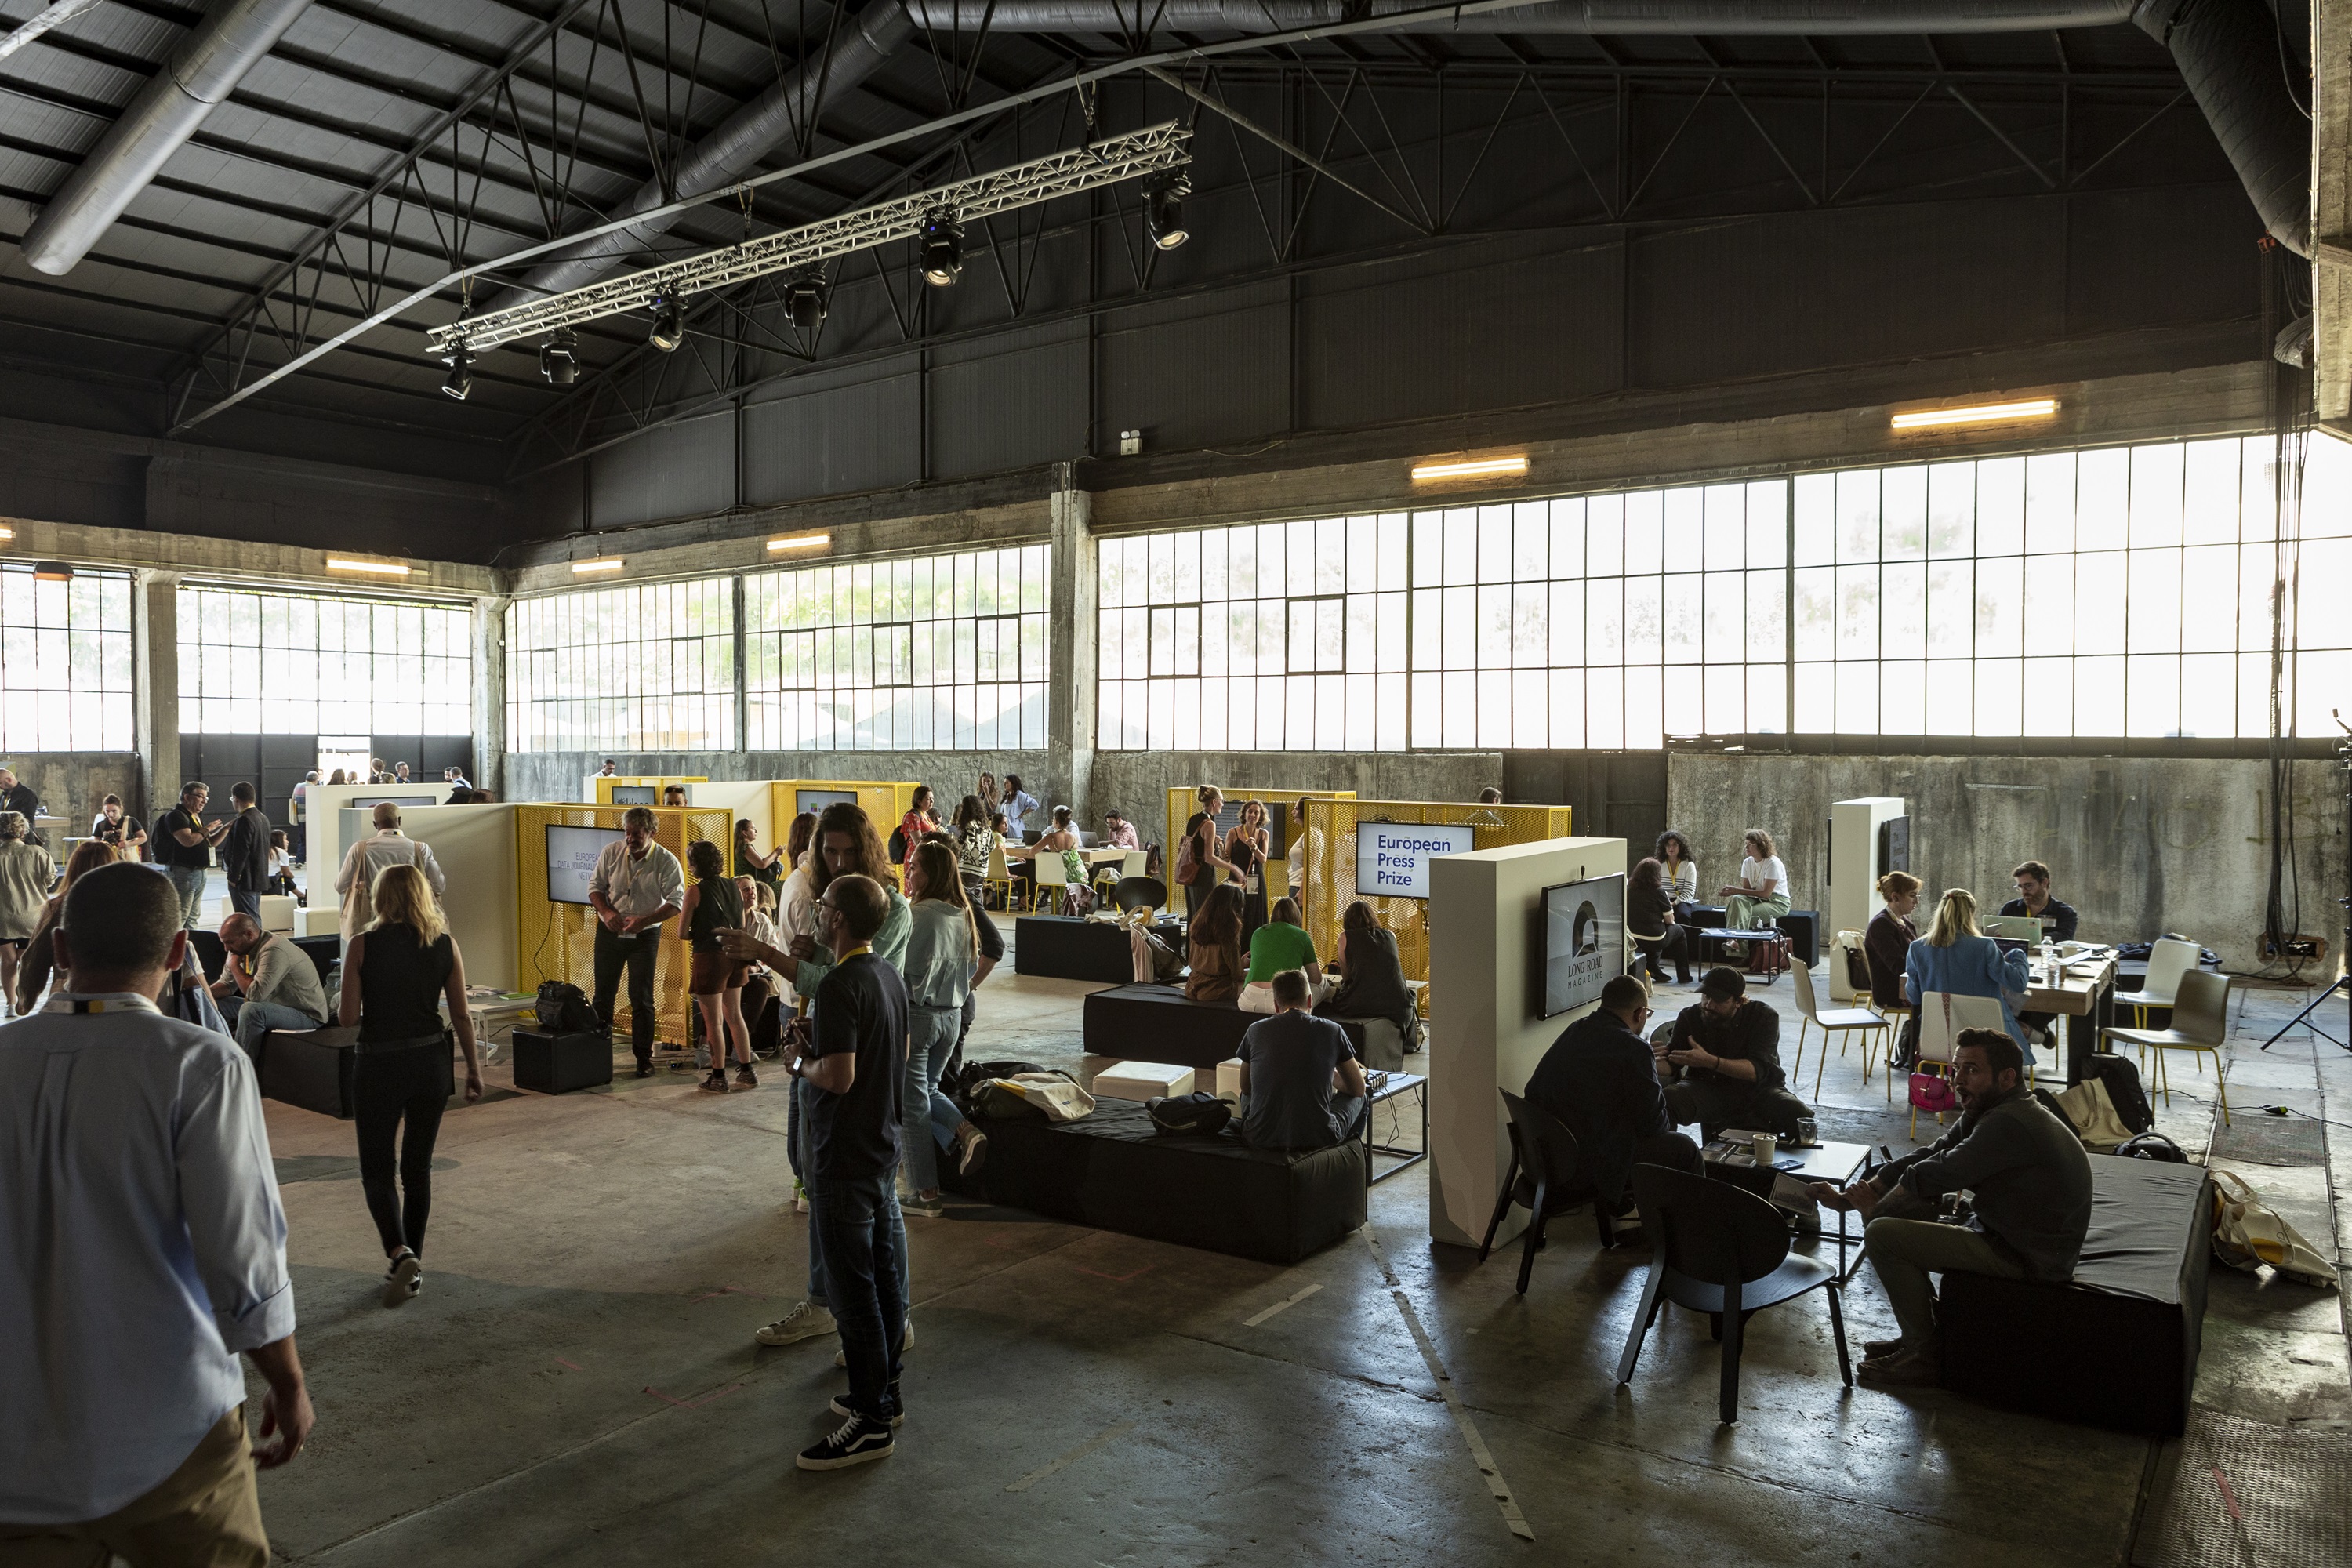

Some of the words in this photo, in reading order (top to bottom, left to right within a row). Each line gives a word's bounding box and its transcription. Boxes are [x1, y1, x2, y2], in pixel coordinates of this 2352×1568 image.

[576, 852, 600, 862] EUROPEA
[557, 860, 569, 869] DATA
[571, 862, 597, 871] JOURNALI
[1568, 962, 1584, 978] LONG
[1587, 956, 1602, 971] ROAD
[1568, 971, 1602, 989] MAGAZINE
